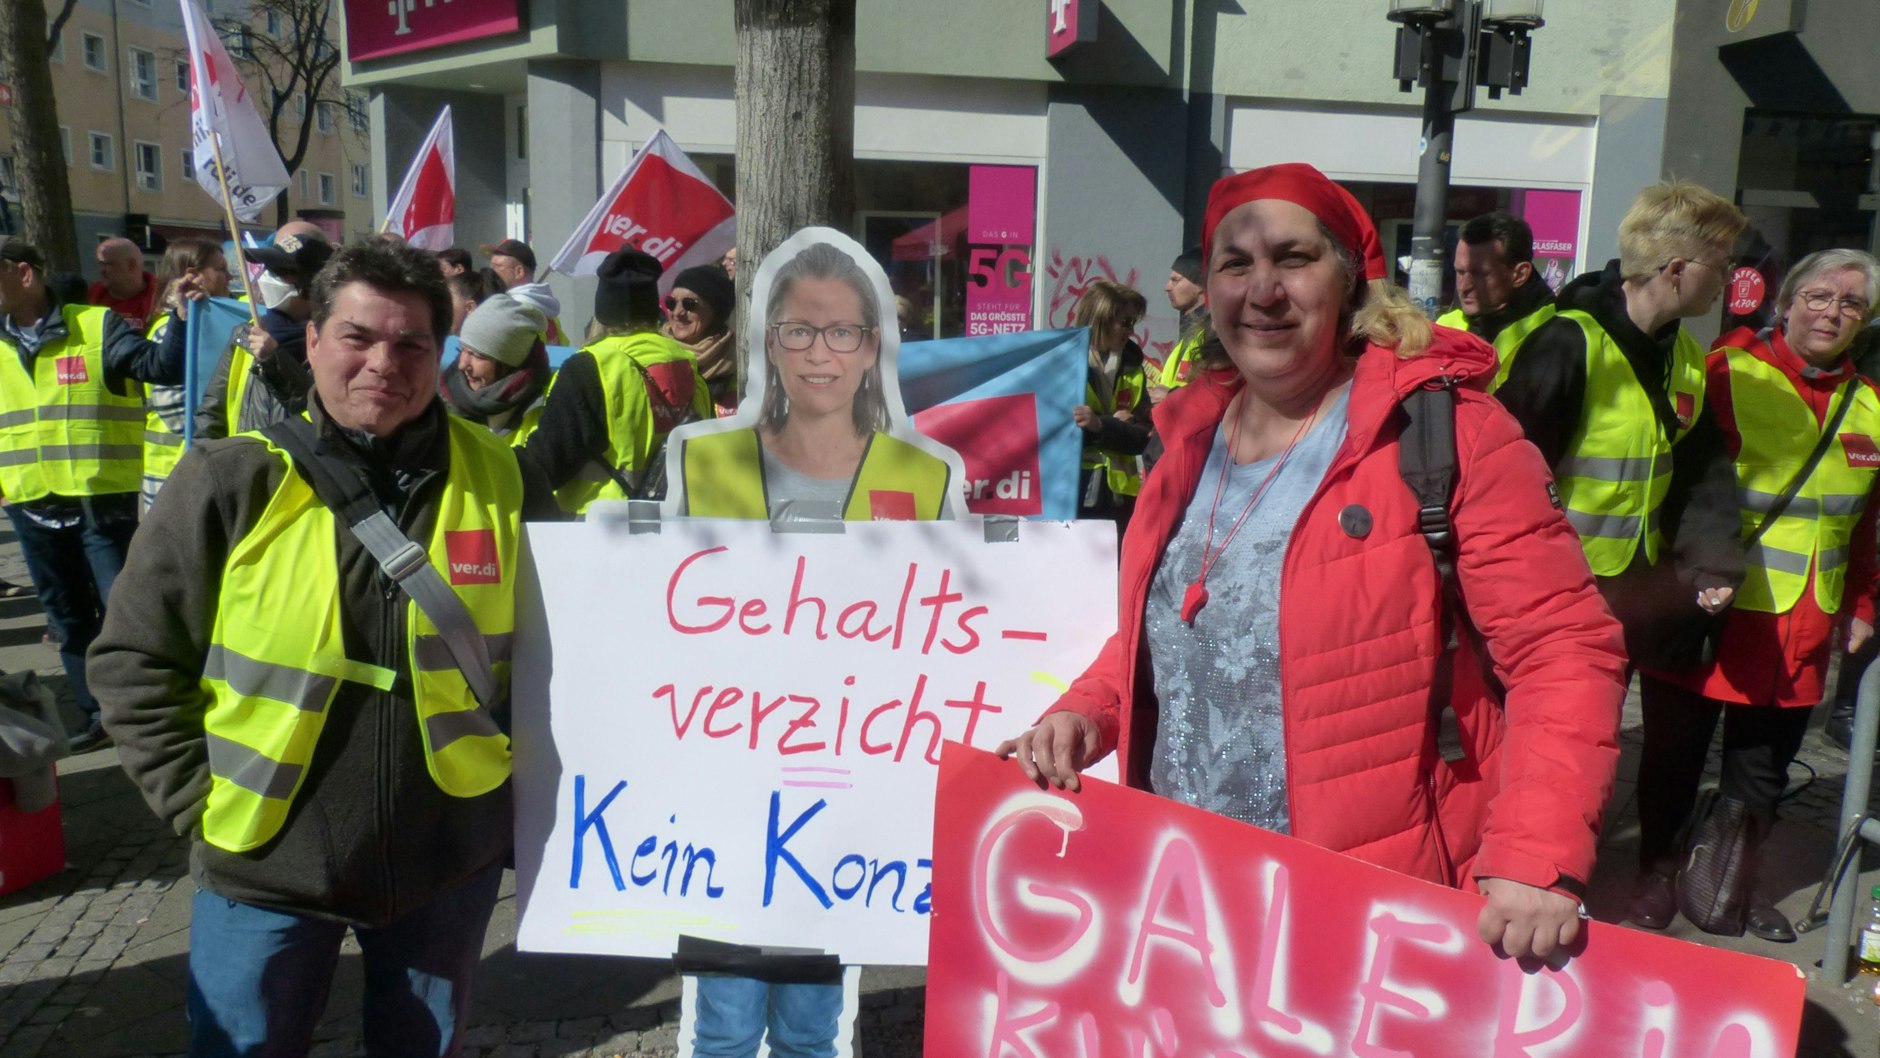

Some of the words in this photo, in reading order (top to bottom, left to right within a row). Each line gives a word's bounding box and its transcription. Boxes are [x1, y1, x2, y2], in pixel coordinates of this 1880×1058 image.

[982, 230, 999, 239] DAS
[1001, 230, 1007, 239] G
[1009, 231, 1019, 239] IN
[1532, 241, 1573, 252] GLASFASER
[967, 248, 1033, 297] 5G
[1731, 269, 1762, 286] AFFEE
[977, 302, 1002, 311] STEHT
[1004, 301, 1020, 311] FÜR
[970, 311, 988, 322] DAS
[988, 310, 1026, 323] GRÖSSTE
[970, 322, 1026, 336] 5G-NETZ
[451, 561, 497, 577] ver.di
[666, 545, 1048, 655] Gehalts-
[651, 673, 1003, 766] verzicht
[569, 774, 724, 899] Kein
